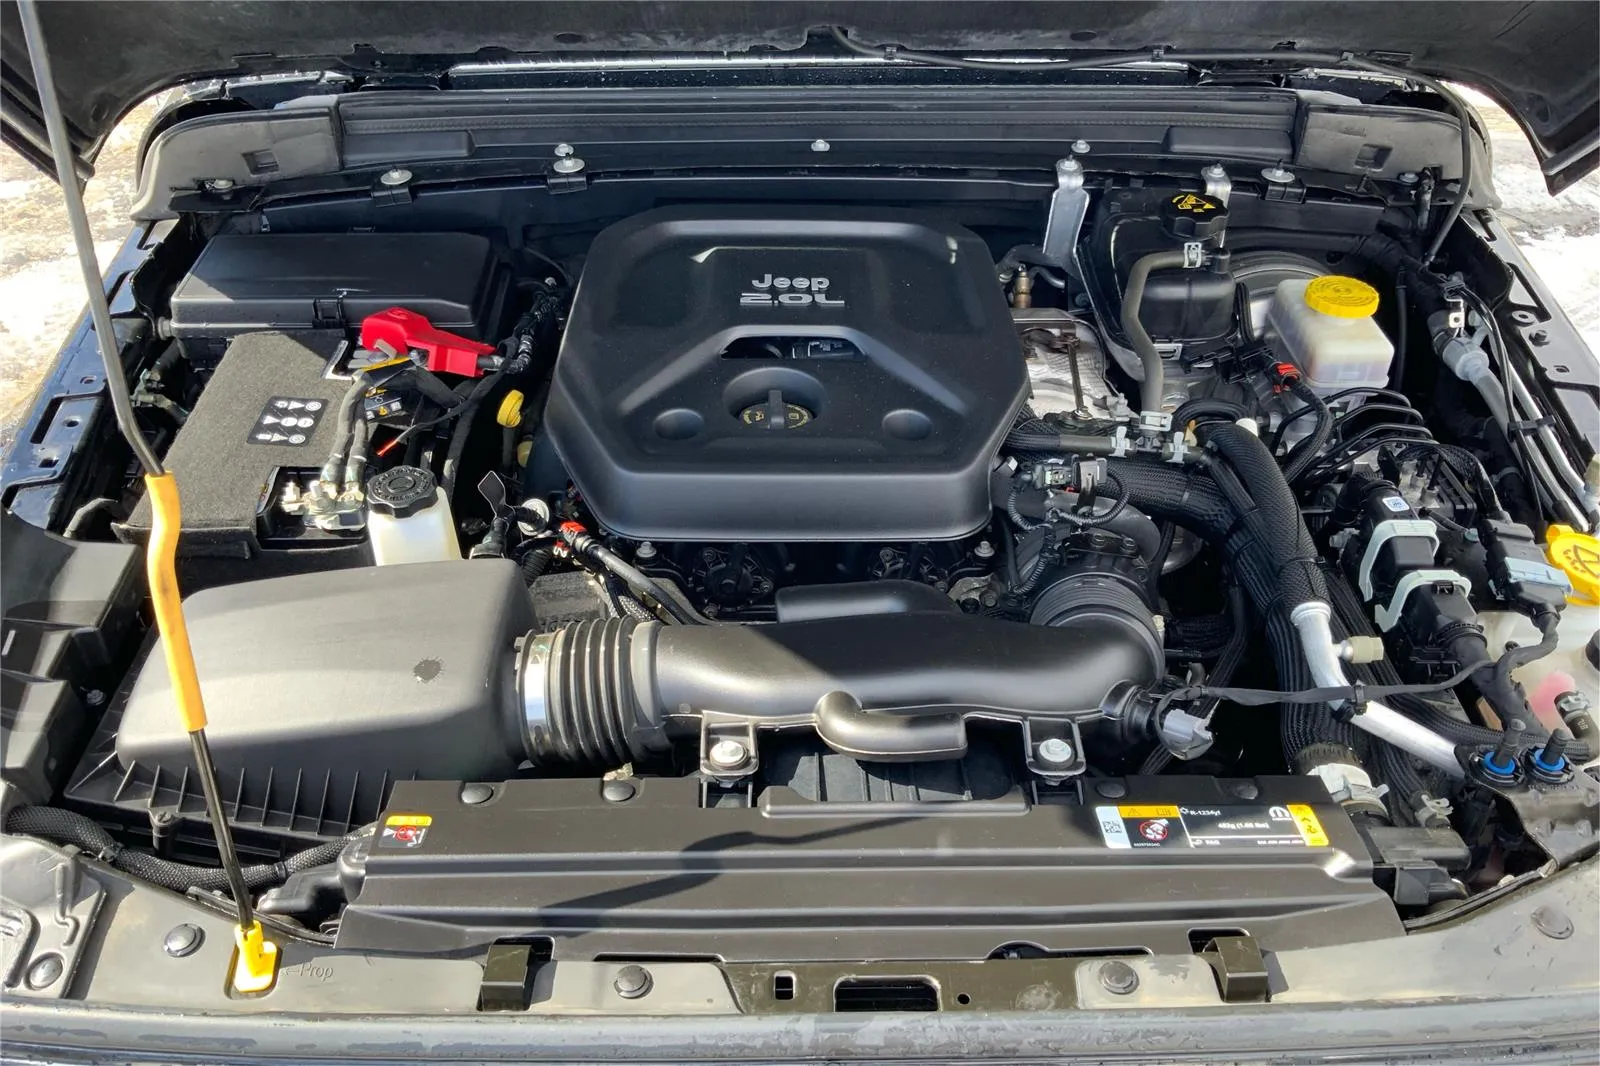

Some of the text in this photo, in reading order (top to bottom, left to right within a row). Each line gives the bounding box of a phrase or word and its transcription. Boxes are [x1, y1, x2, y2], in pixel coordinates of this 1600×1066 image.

[752, 273, 830, 291] Jeep
[740, 292, 845, 306] 2.0L
[300, 962, 334, 982] Prop
